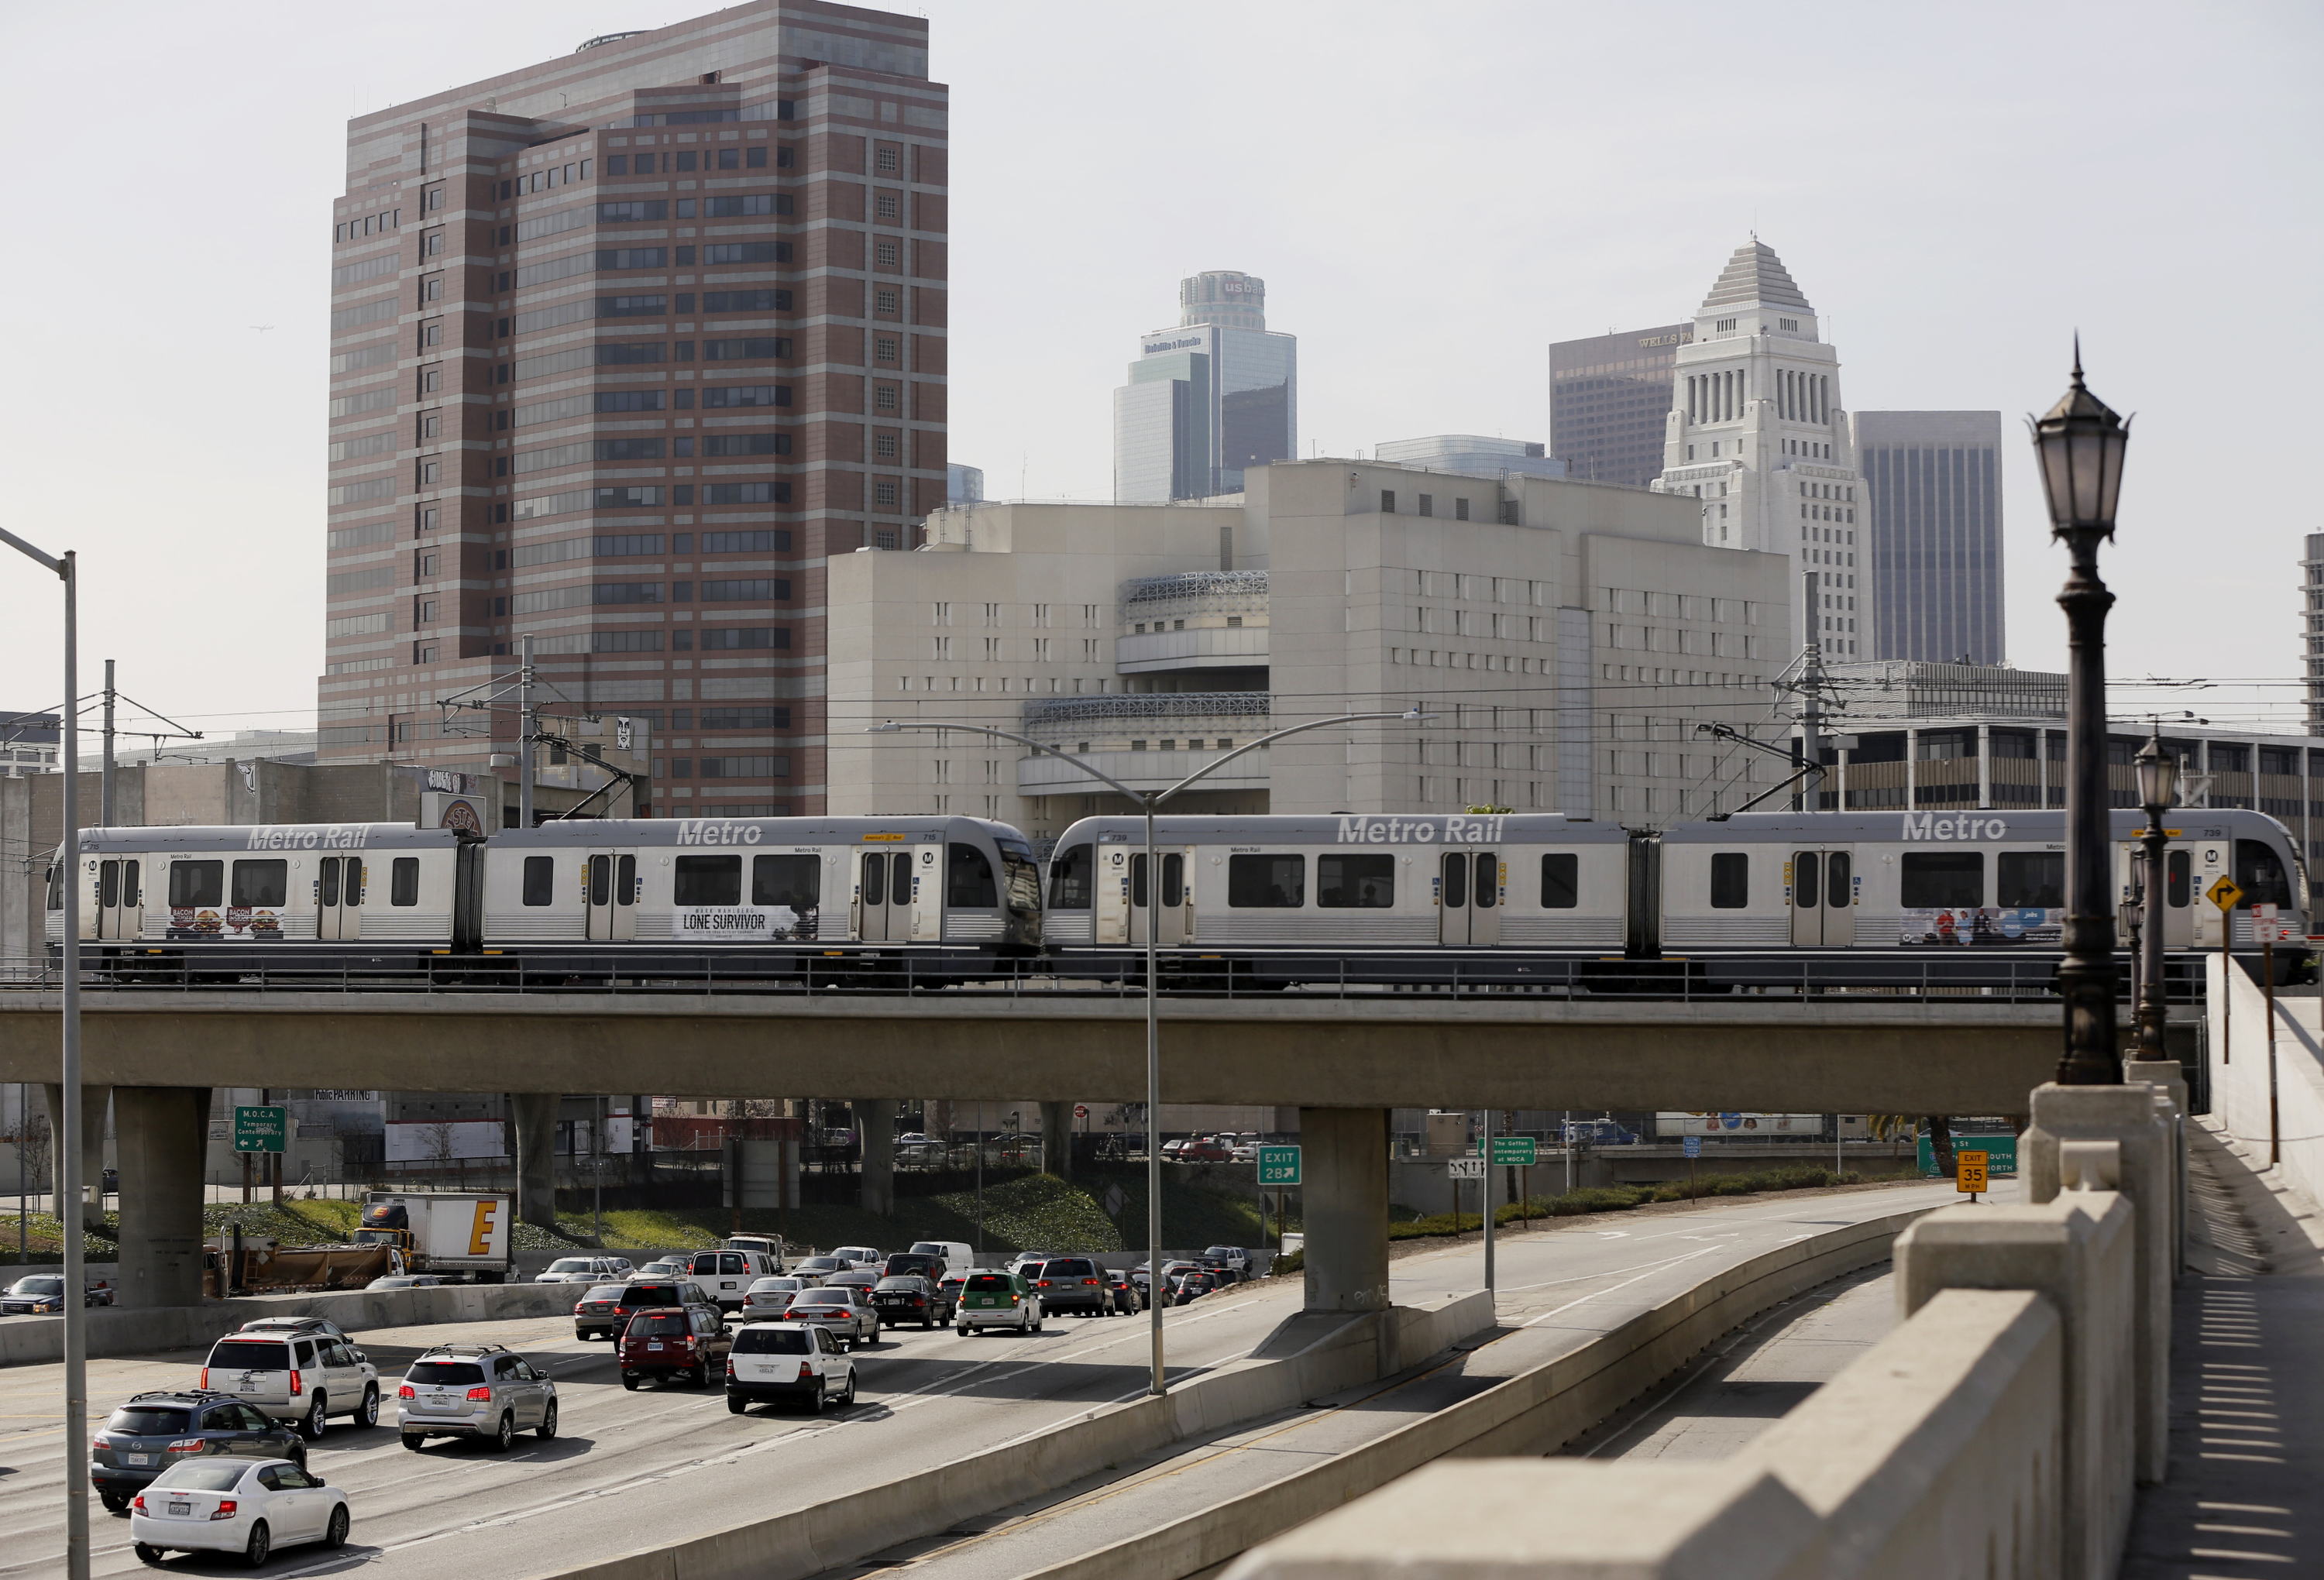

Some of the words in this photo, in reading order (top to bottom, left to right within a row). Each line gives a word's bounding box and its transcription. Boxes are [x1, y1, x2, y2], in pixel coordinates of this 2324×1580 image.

[1145, 342, 1171, 354] Deloitte
[1177, 337, 1201, 349] Touche
[1639, 334, 1677, 348] WELLS
[676, 821, 761, 845] Metro
[1337, 817, 1434, 843] Metro
[1444, 816, 1504, 842] Rail
[1902, 814, 2006, 840] Metro
[247, 827, 318, 850] Metro
[323, 825, 370, 848] Rail
[2252, 906, 2260, 915] NO
[684, 915, 710, 929] LONE
[713, 915, 765, 929] SURVIVOR
[1265, 1153, 1294, 1163] EXIT
[1266, 1168, 1282, 1179] 2B
[1964, 1169, 1982, 1181] 35
[373, 1207, 387, 1216] E
[468, 1200, 497, 1255] E
